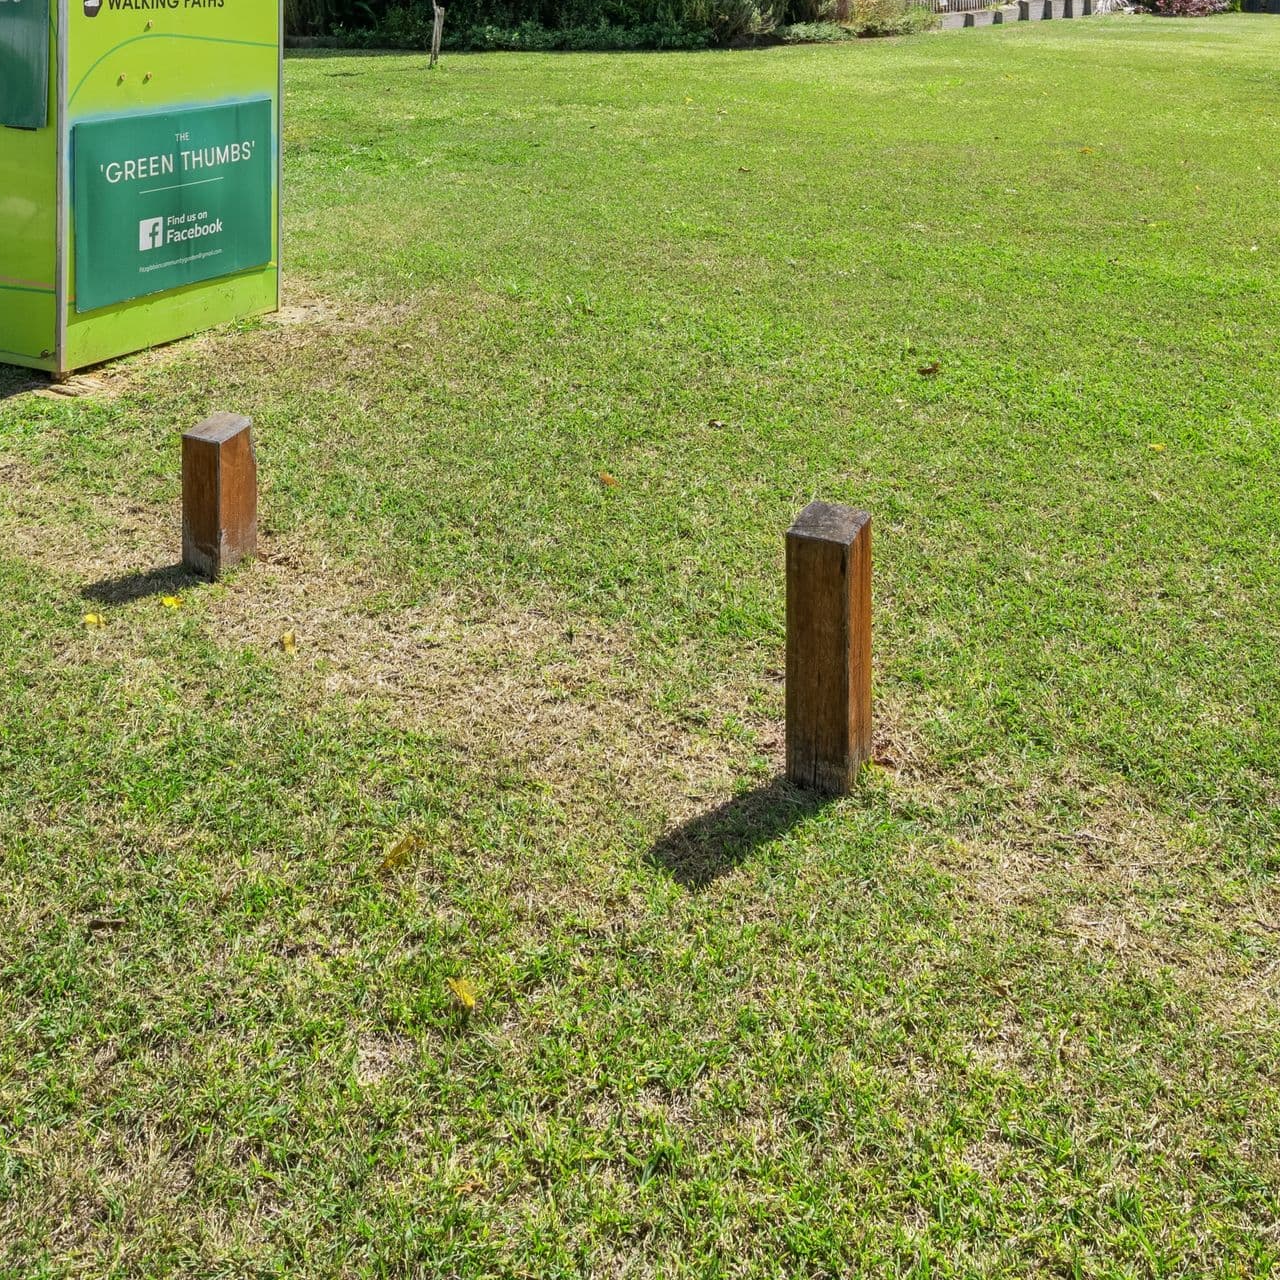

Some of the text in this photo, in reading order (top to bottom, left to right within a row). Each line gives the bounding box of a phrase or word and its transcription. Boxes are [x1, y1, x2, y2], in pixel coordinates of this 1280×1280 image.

[175, 132, 190, 142] THE
[100, 140, 256, 184] 'GREEN THUMBS'
[167, 215, 185, 226] Find
[187, 214, 196, 222] us
[198, 211, 208, 220] on
[166, 218, 223, 243] Facebook
